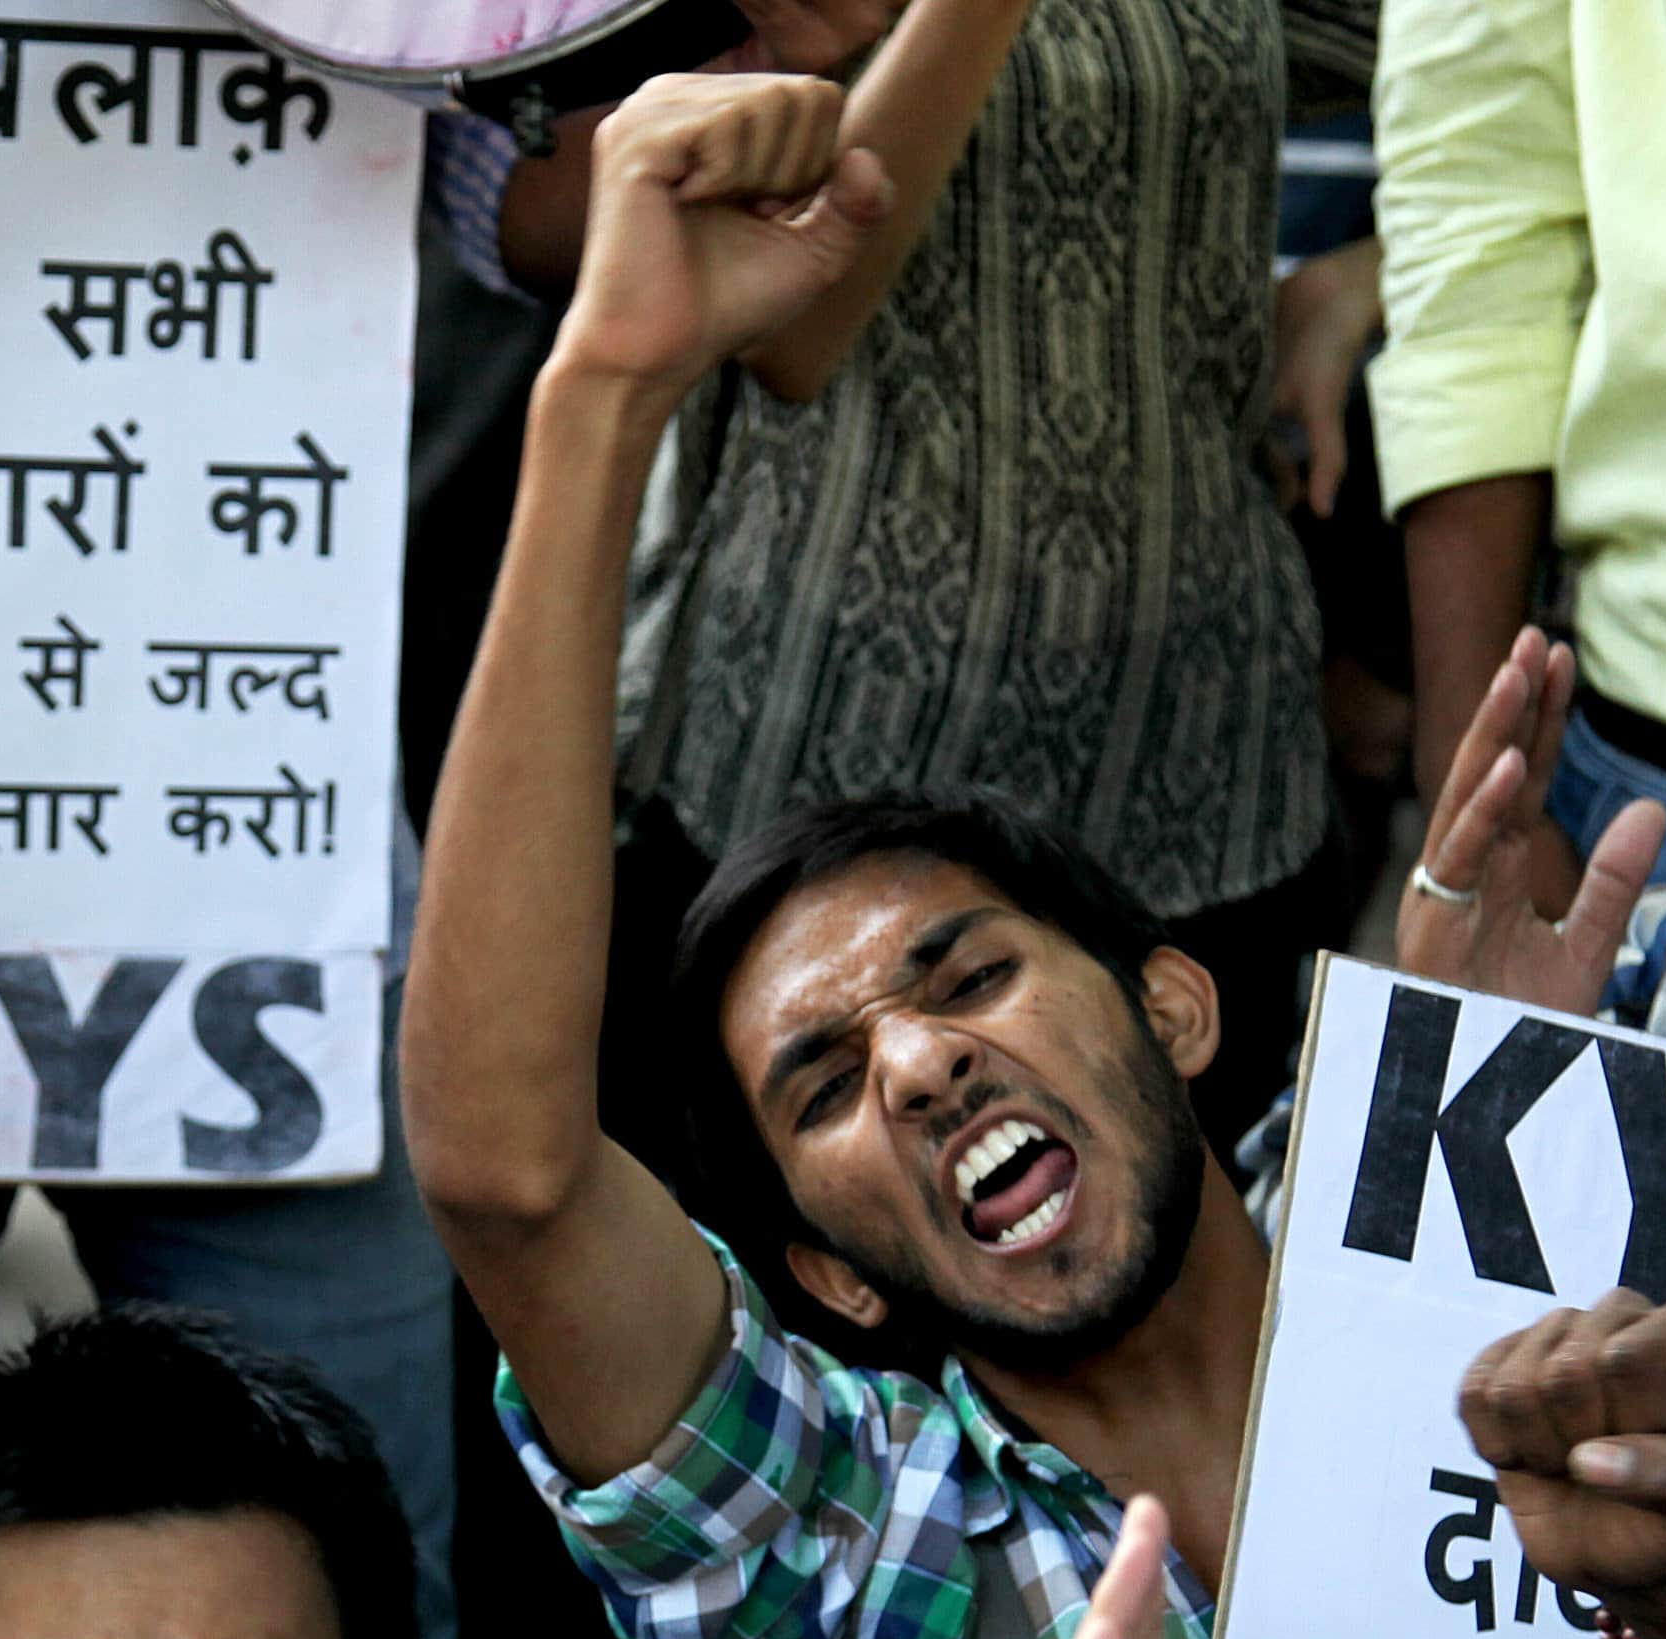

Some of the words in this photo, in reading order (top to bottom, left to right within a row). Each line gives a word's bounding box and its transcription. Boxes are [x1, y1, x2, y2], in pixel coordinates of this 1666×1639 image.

[41, 229, 273, 361] सभी
[208, 430, 347, 556] को
[22, 614, 99, 711] से
[146, 642, 340, 719] जल्द
[164, 764, 336, 858] करो!
